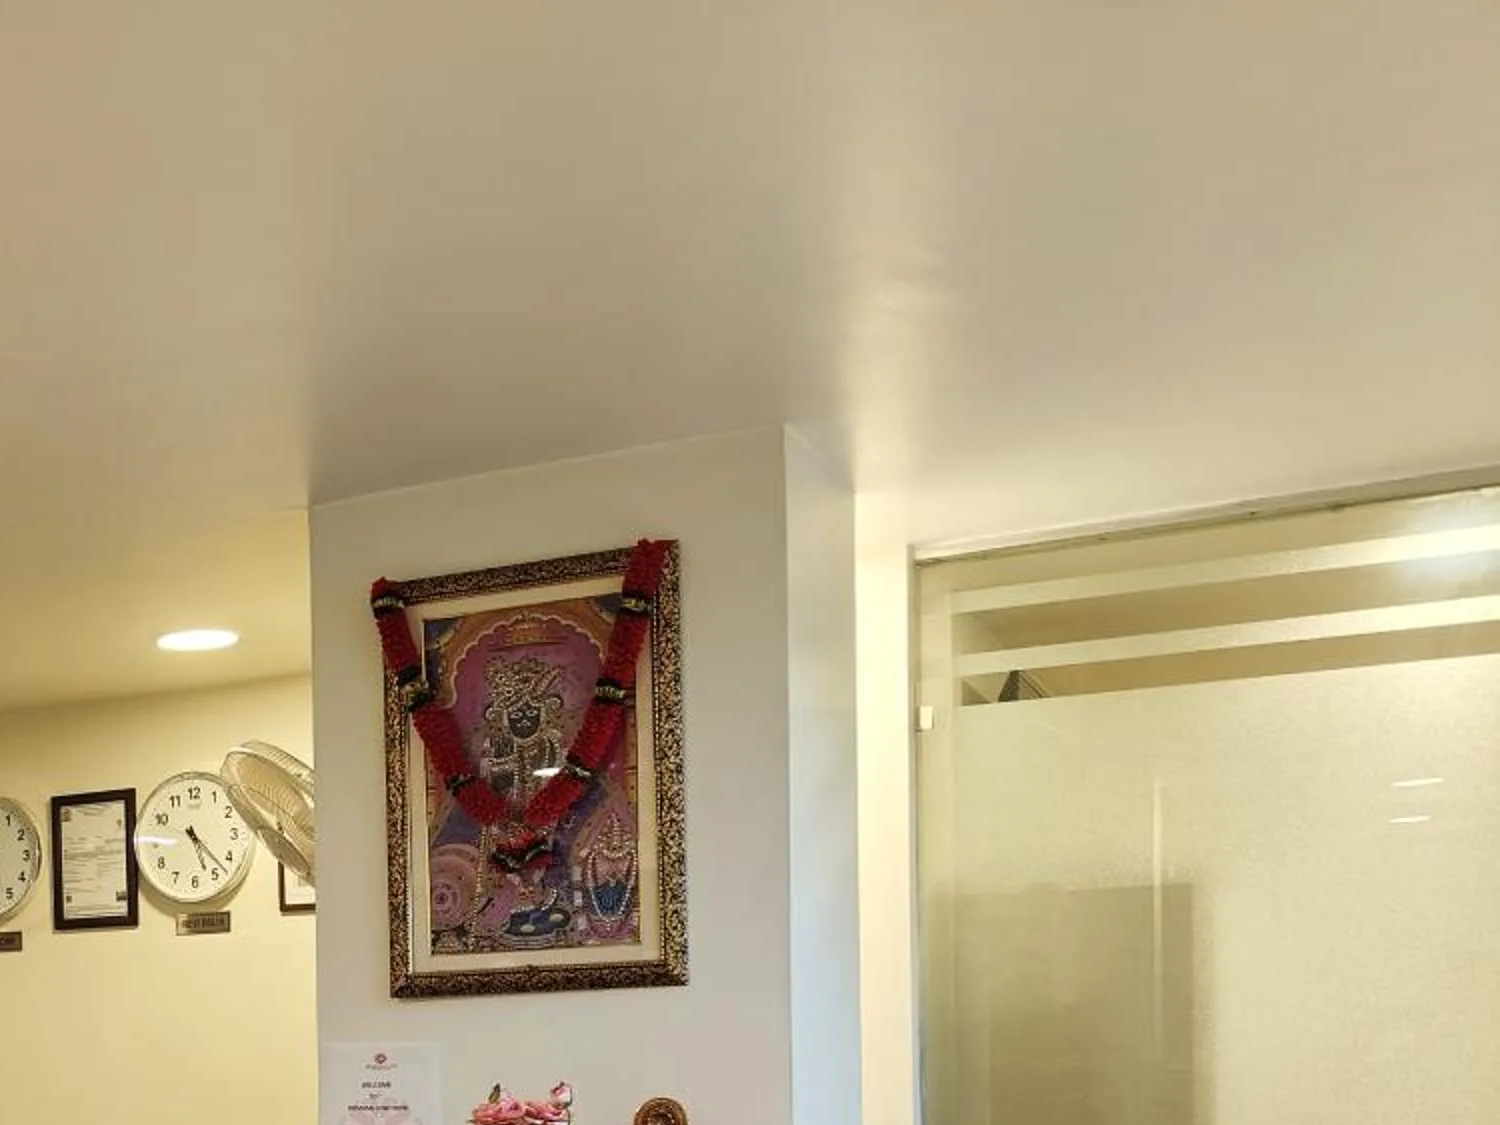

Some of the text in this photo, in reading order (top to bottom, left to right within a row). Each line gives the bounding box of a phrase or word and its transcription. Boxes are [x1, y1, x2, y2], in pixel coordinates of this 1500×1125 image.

[187, 787, 200, 800] 12
[212, 792, 217, 804] 1
[170, 795, 181, 808] 11
[224, 806, 233, 819] 2
[6, 815, 11, 826] 1
[155, 813, 168, 825] 10
[17, 829, 25, 840] 2
[230, 828, 238, 841] 3
[22, 850, 30, 862] 3
[225, 851, 233, 863] 4
[157, 857, 165, 869] 8
[18, 871, 26, 882] 4
[172, 871, 180, 884] 7
[211, 868, 219, 881] 5
[192, 875, 199, 889] 6
[6, 888, 13, 899] 5
